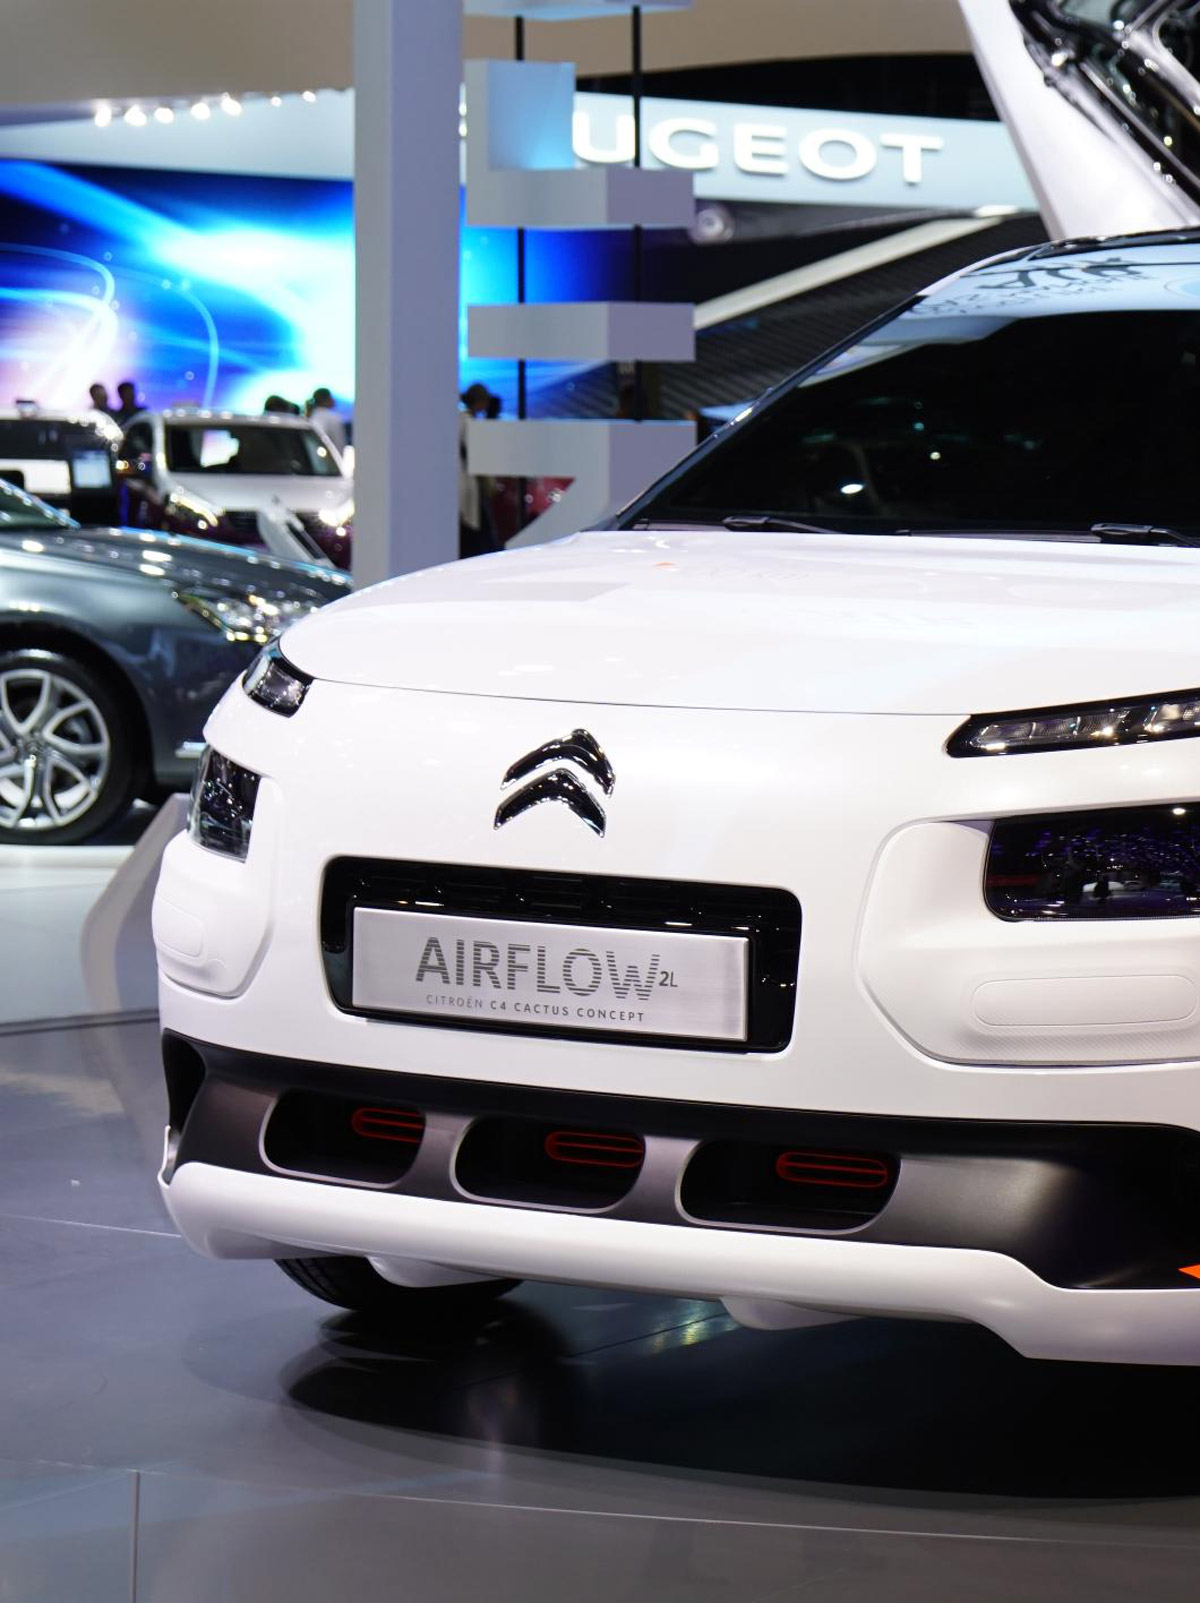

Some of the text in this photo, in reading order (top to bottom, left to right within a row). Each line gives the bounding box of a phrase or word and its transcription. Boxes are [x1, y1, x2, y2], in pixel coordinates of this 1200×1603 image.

[415, 936, 678, 1001] AIRFLOW 2L
[426, 994, 645, 1022] CITROËN C4 CACTUS CONCEPT
